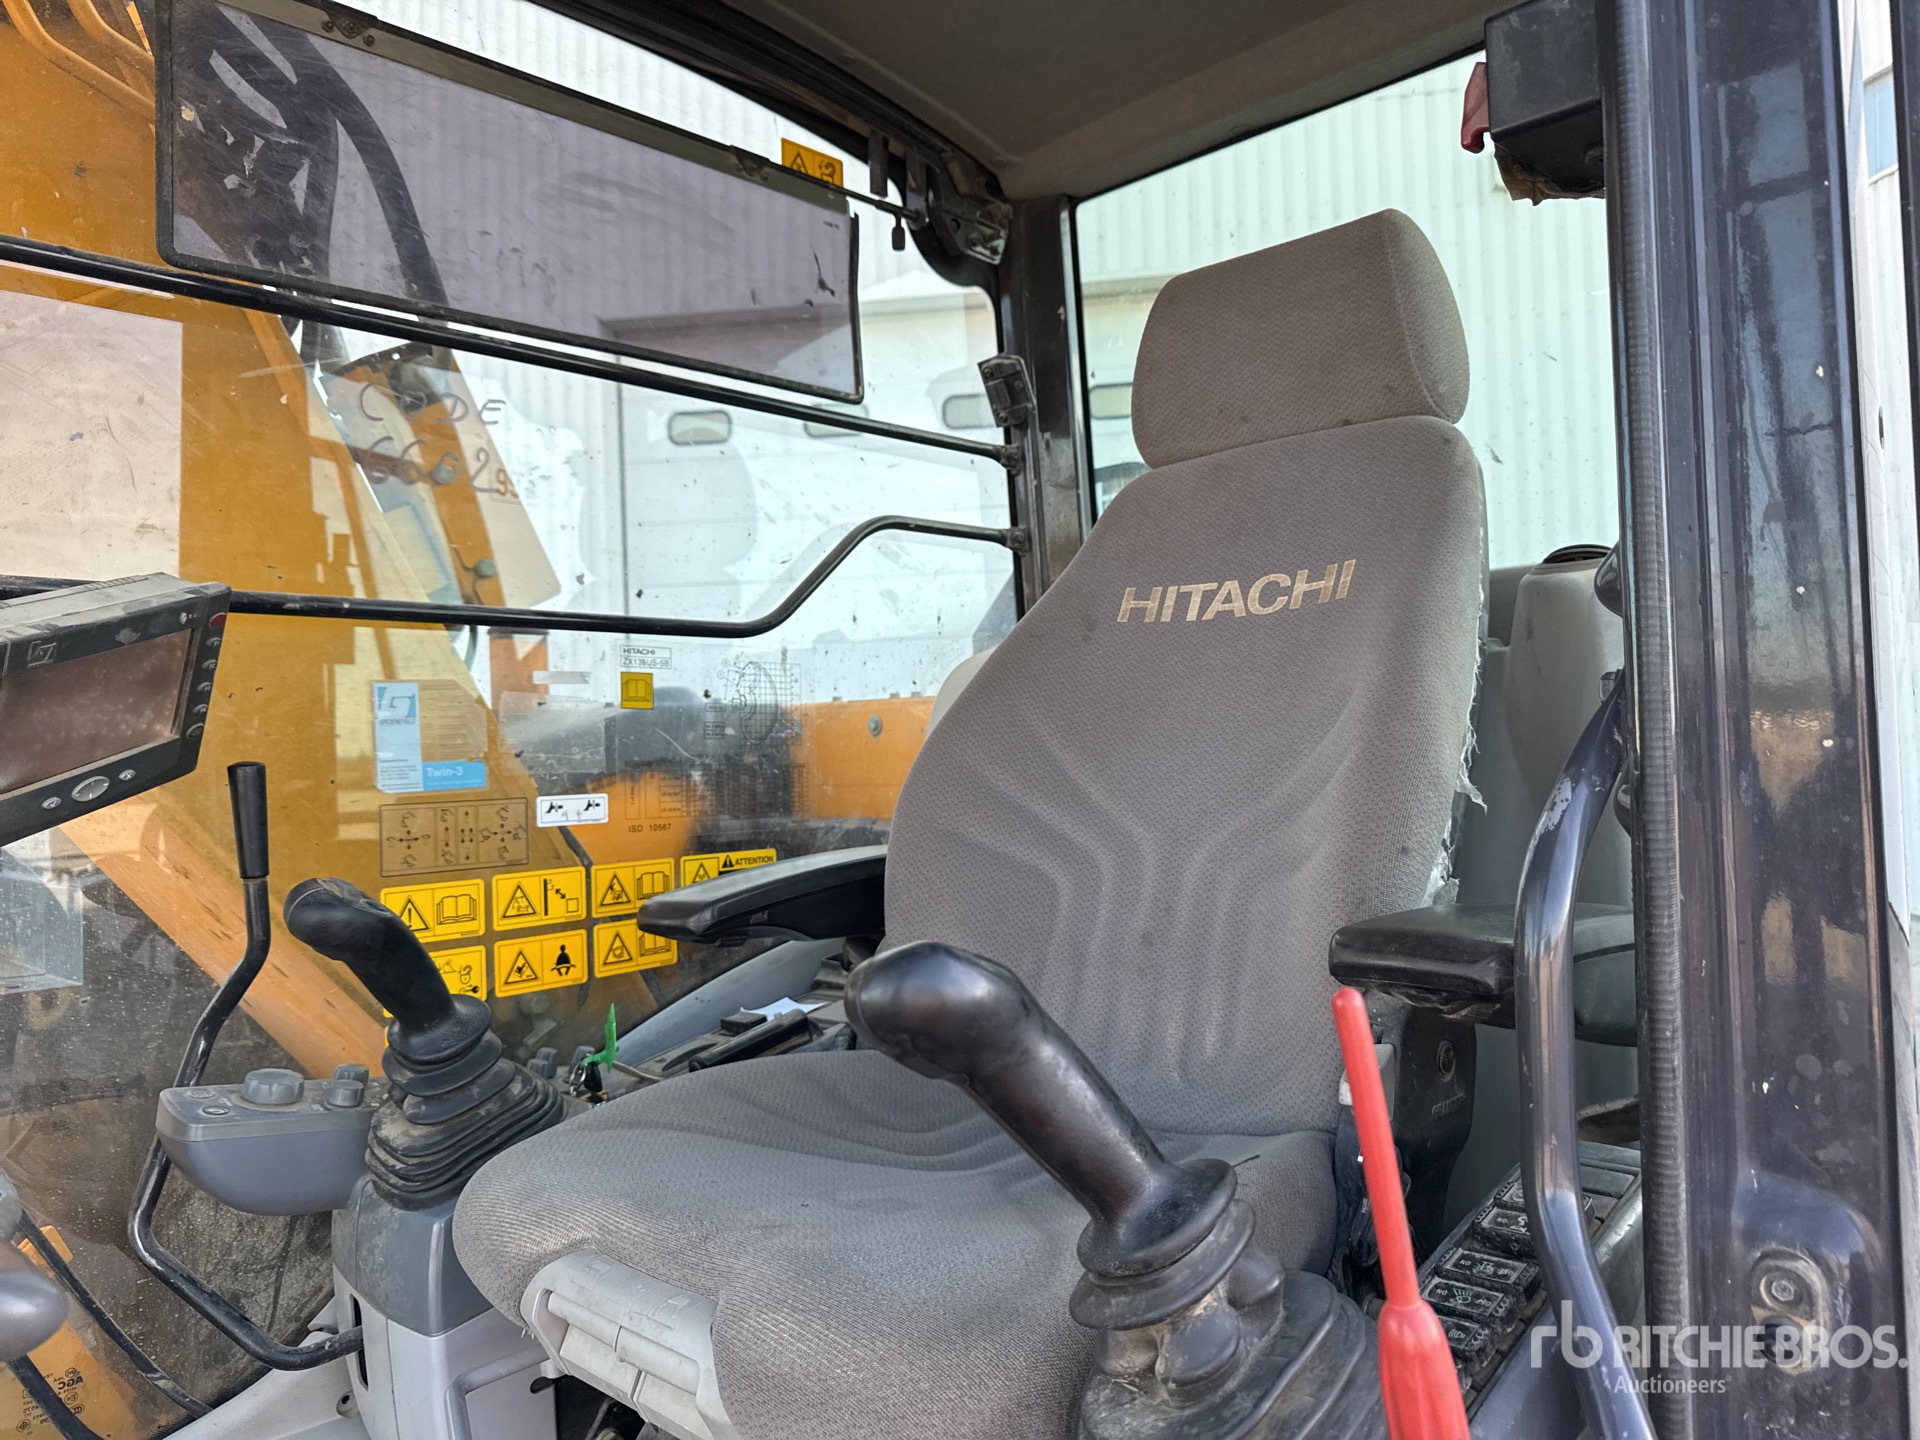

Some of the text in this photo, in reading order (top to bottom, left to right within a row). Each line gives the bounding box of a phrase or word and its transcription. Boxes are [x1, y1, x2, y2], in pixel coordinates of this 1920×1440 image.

[1116, 559, 1356, 622] HITACHI
[623, 647, 656, 656] HITACHI
[425, 766, 464, 778] Twin-3
[627, 824, 643, 833] ISO
[734, 855, 774, 866] ATTENTION
